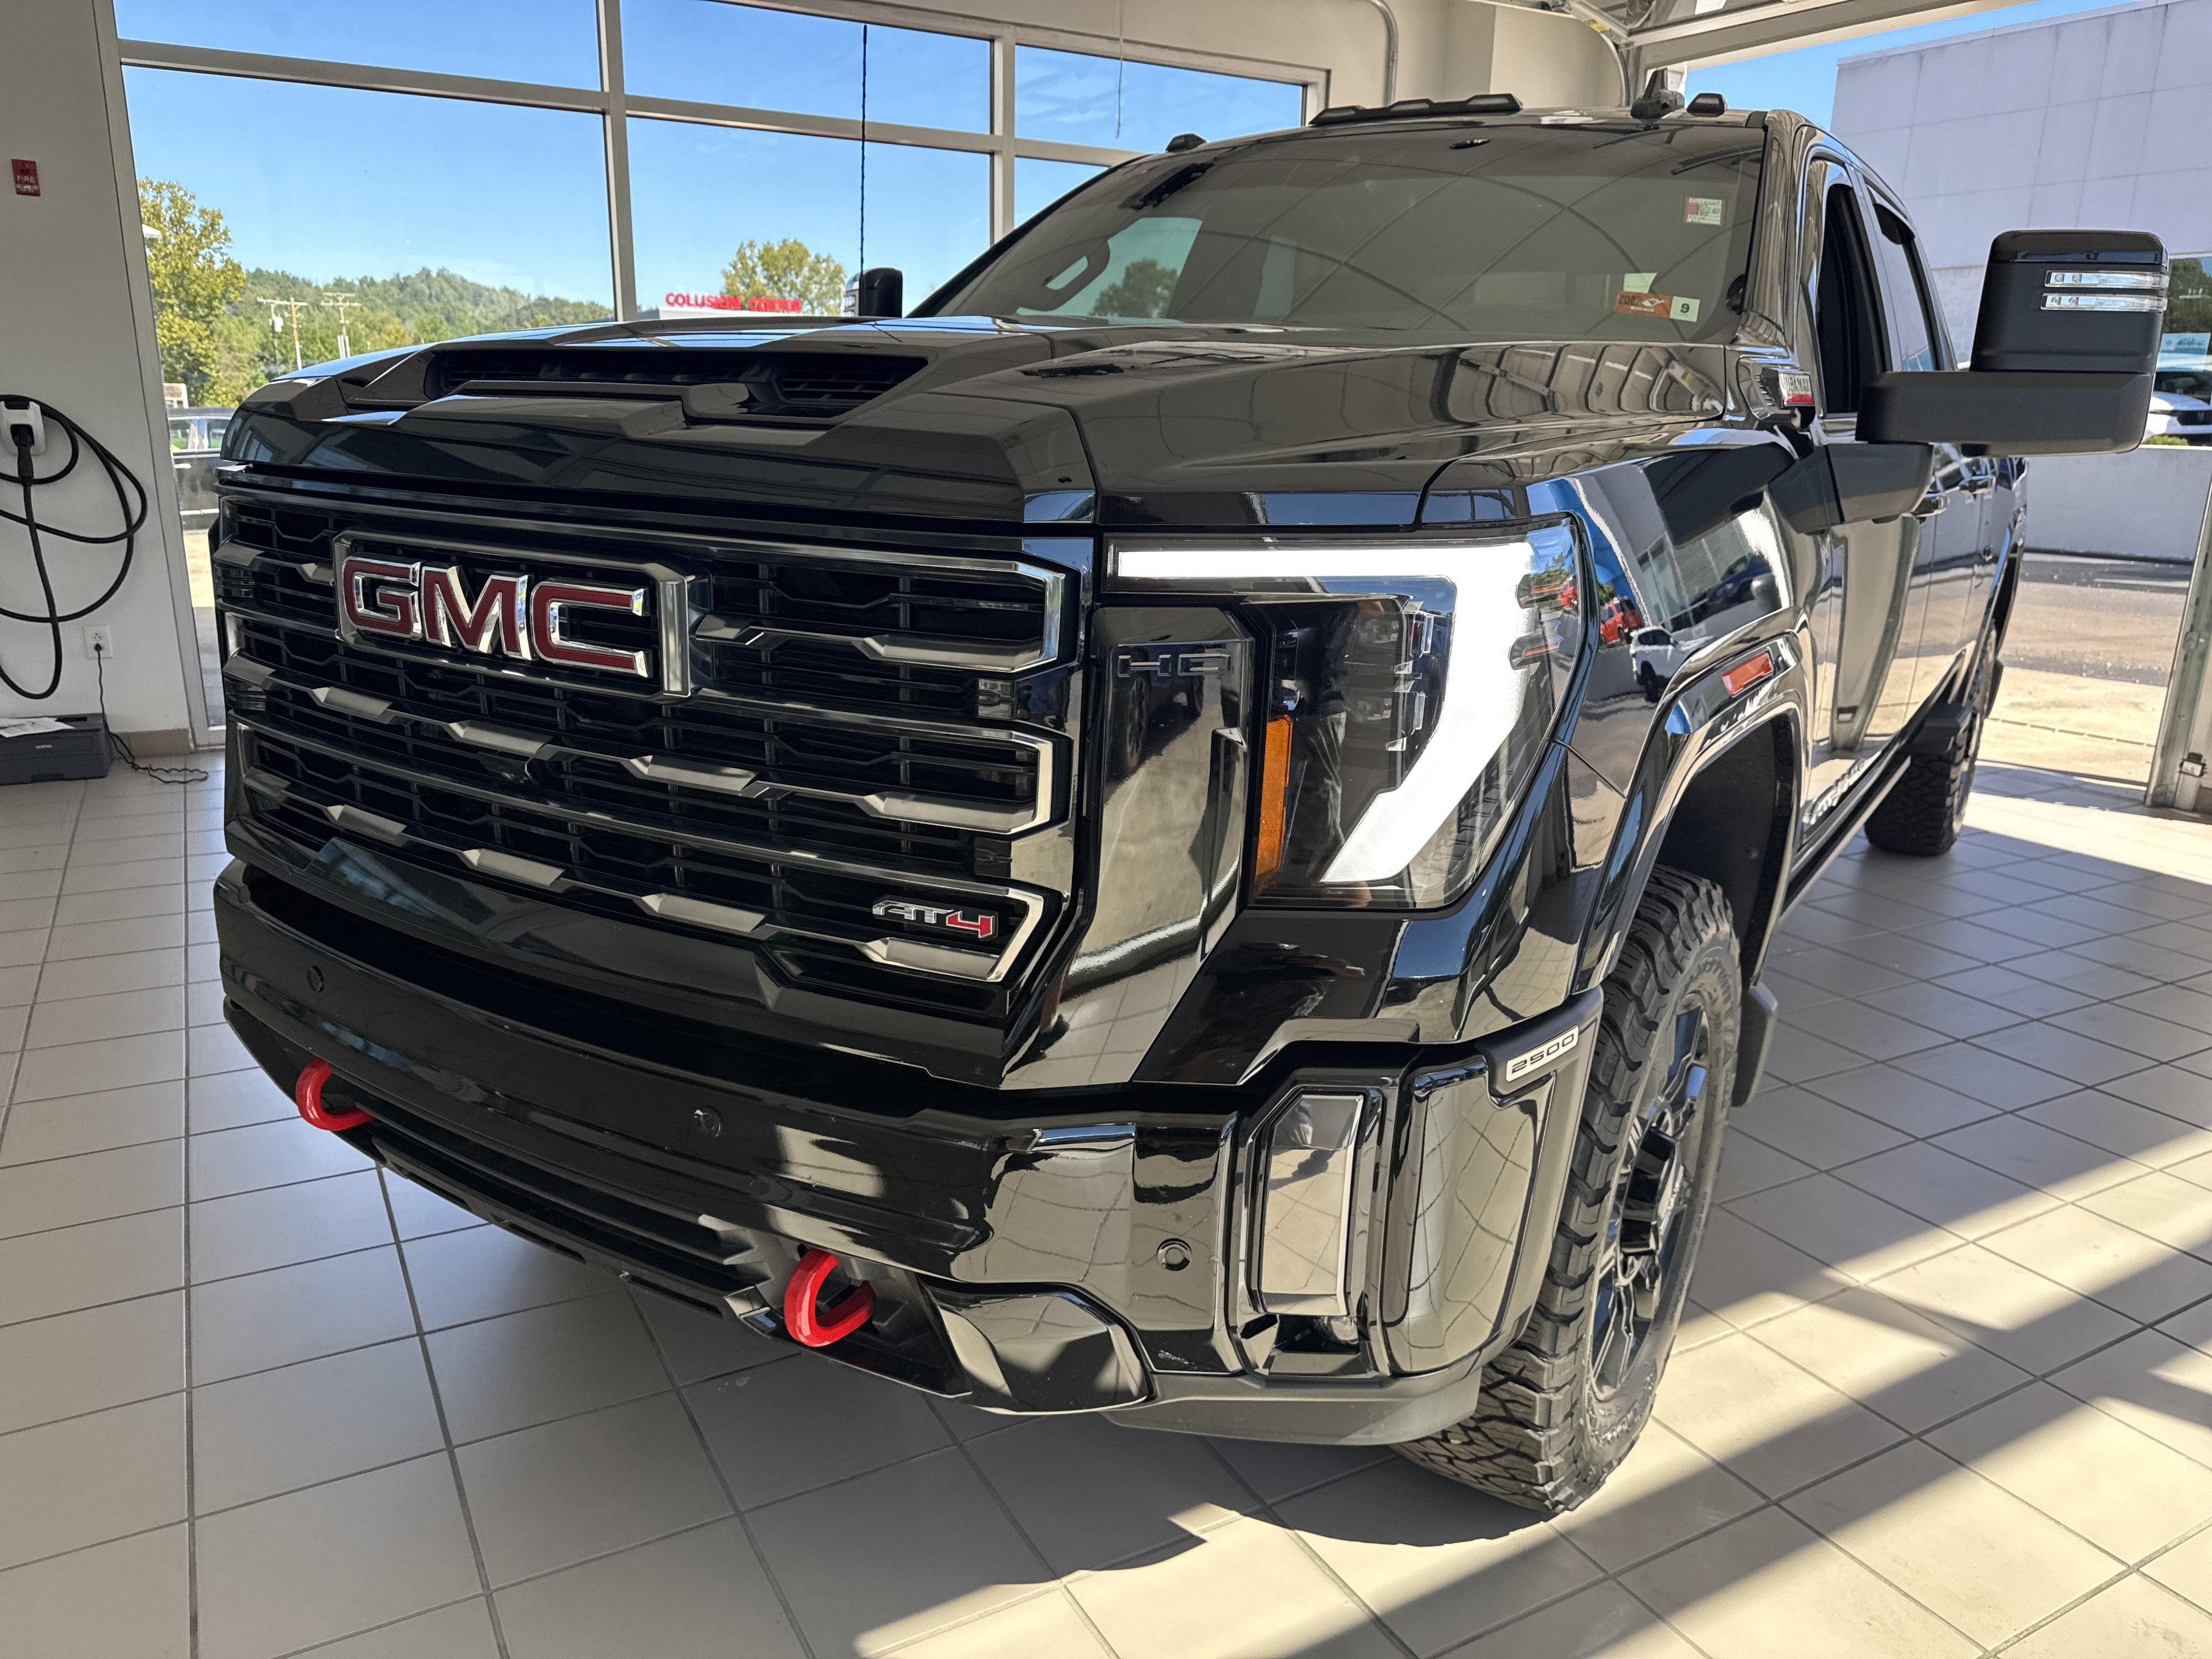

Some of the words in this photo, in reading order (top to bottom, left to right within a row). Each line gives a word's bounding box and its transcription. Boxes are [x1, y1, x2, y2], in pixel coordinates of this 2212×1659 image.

[665, 292, 741, 311] COLLISION
[748, 297, 801, 313] CENTER
[1680, 303, 1690, 313] 9
[341, 556, 648, 678] GMC
[872, 900, 995, 939] AT4
[1511, 1033, 1575, 1074] 2500
